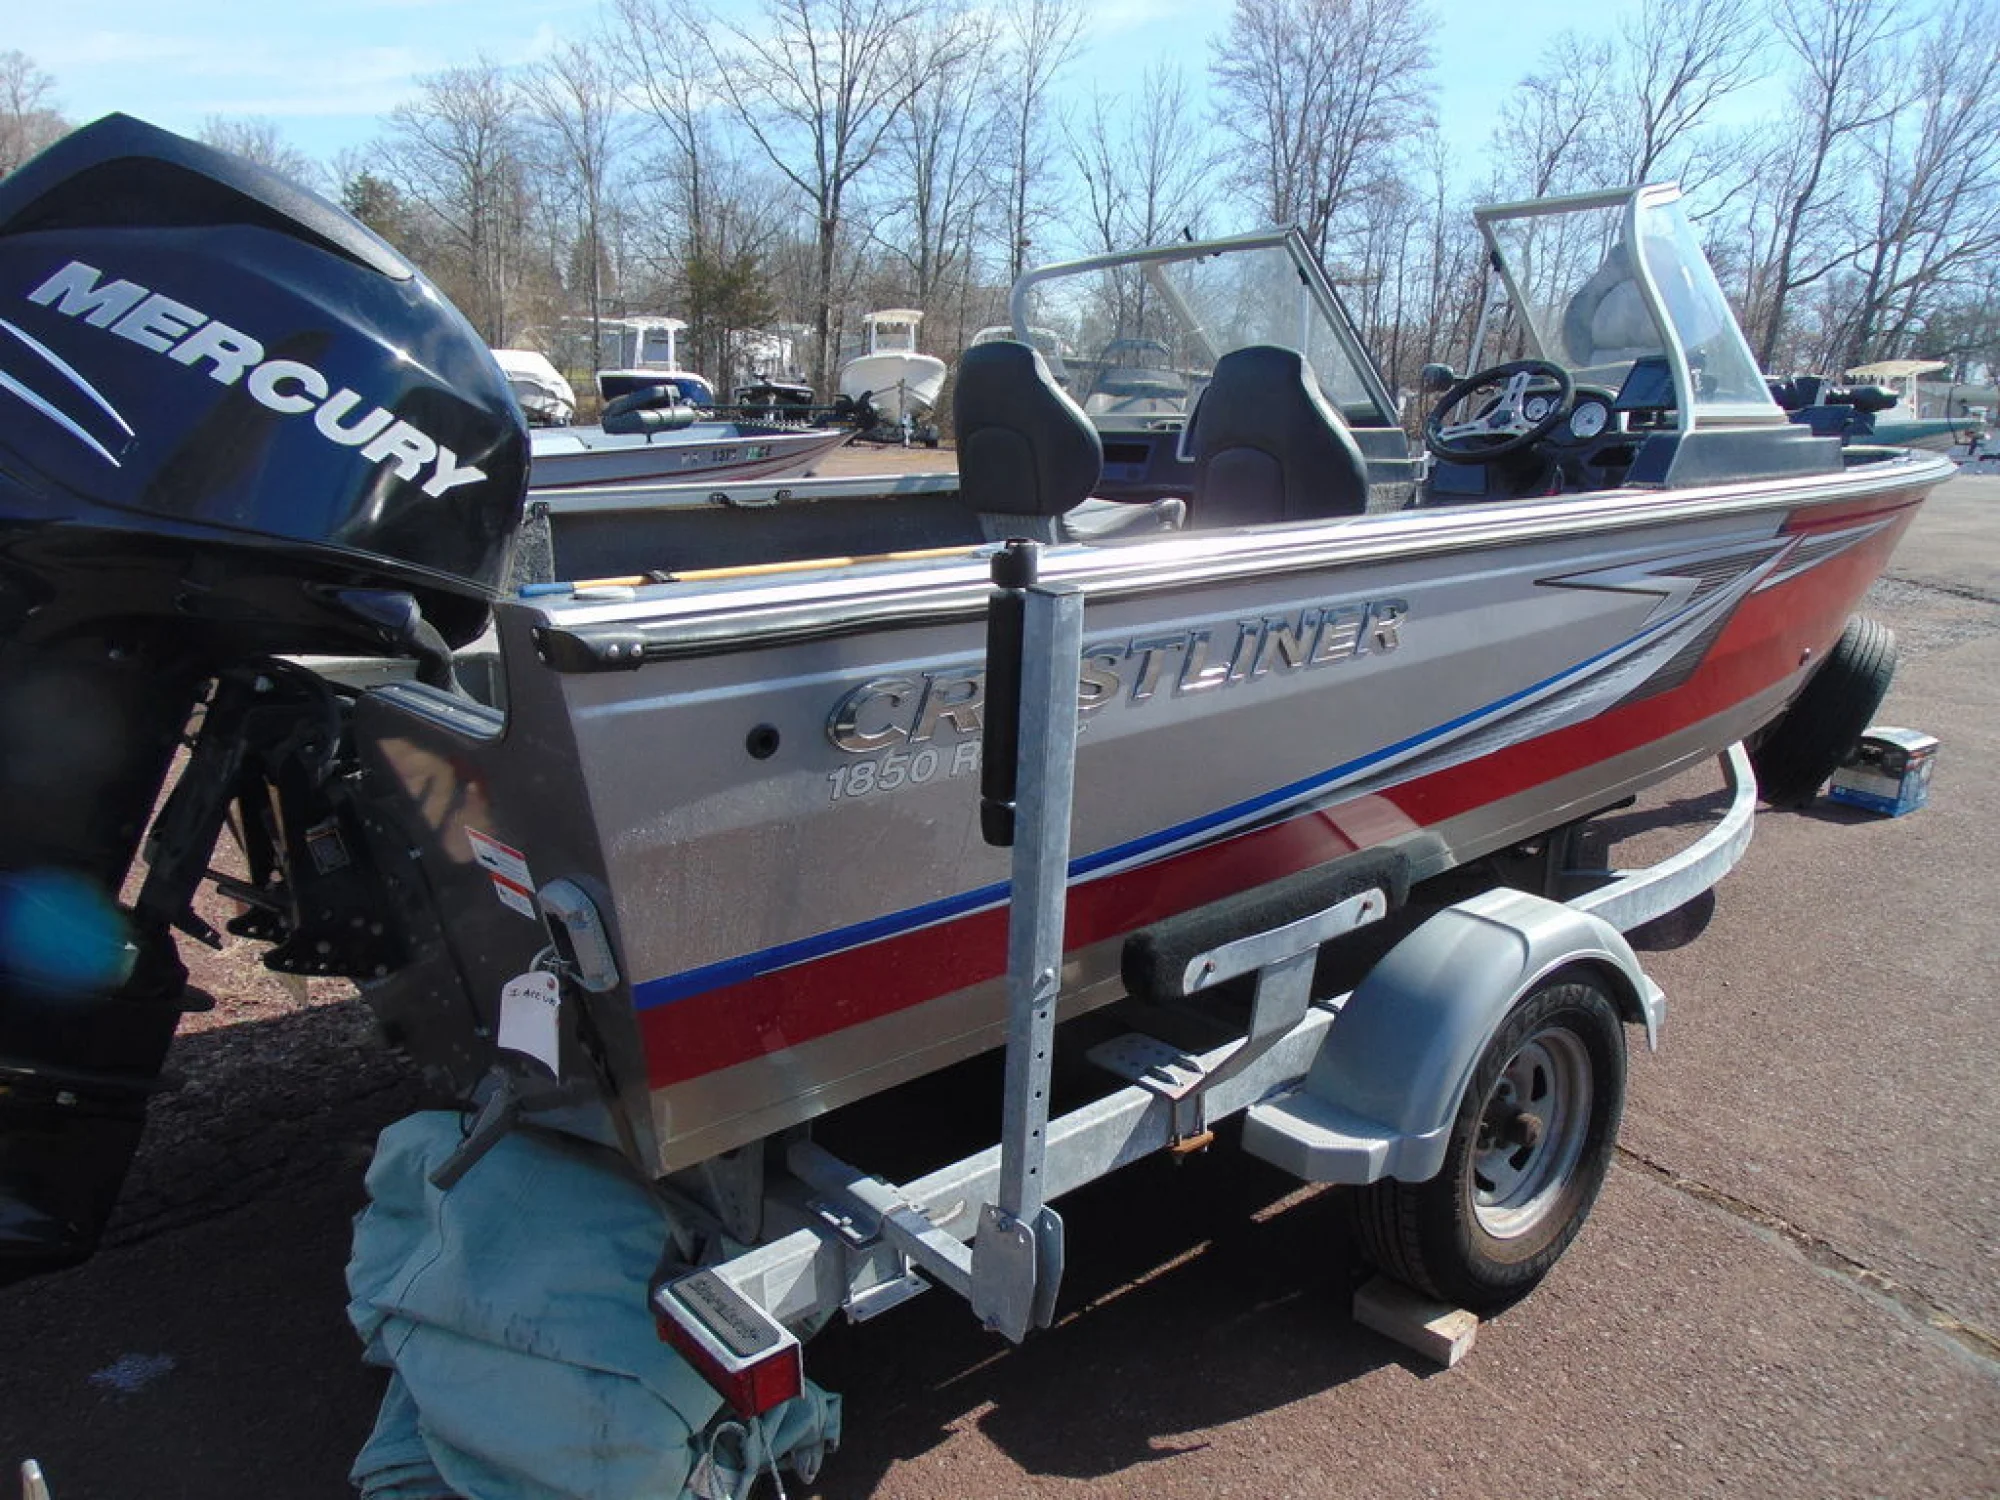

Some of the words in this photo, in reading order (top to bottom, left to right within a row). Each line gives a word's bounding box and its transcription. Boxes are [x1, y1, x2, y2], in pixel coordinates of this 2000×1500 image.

[27, 261, 488, 498] MERCURY
[827, 598, 1408, 753] CRSTLINER
[827, 743, 939, 801] 1850
